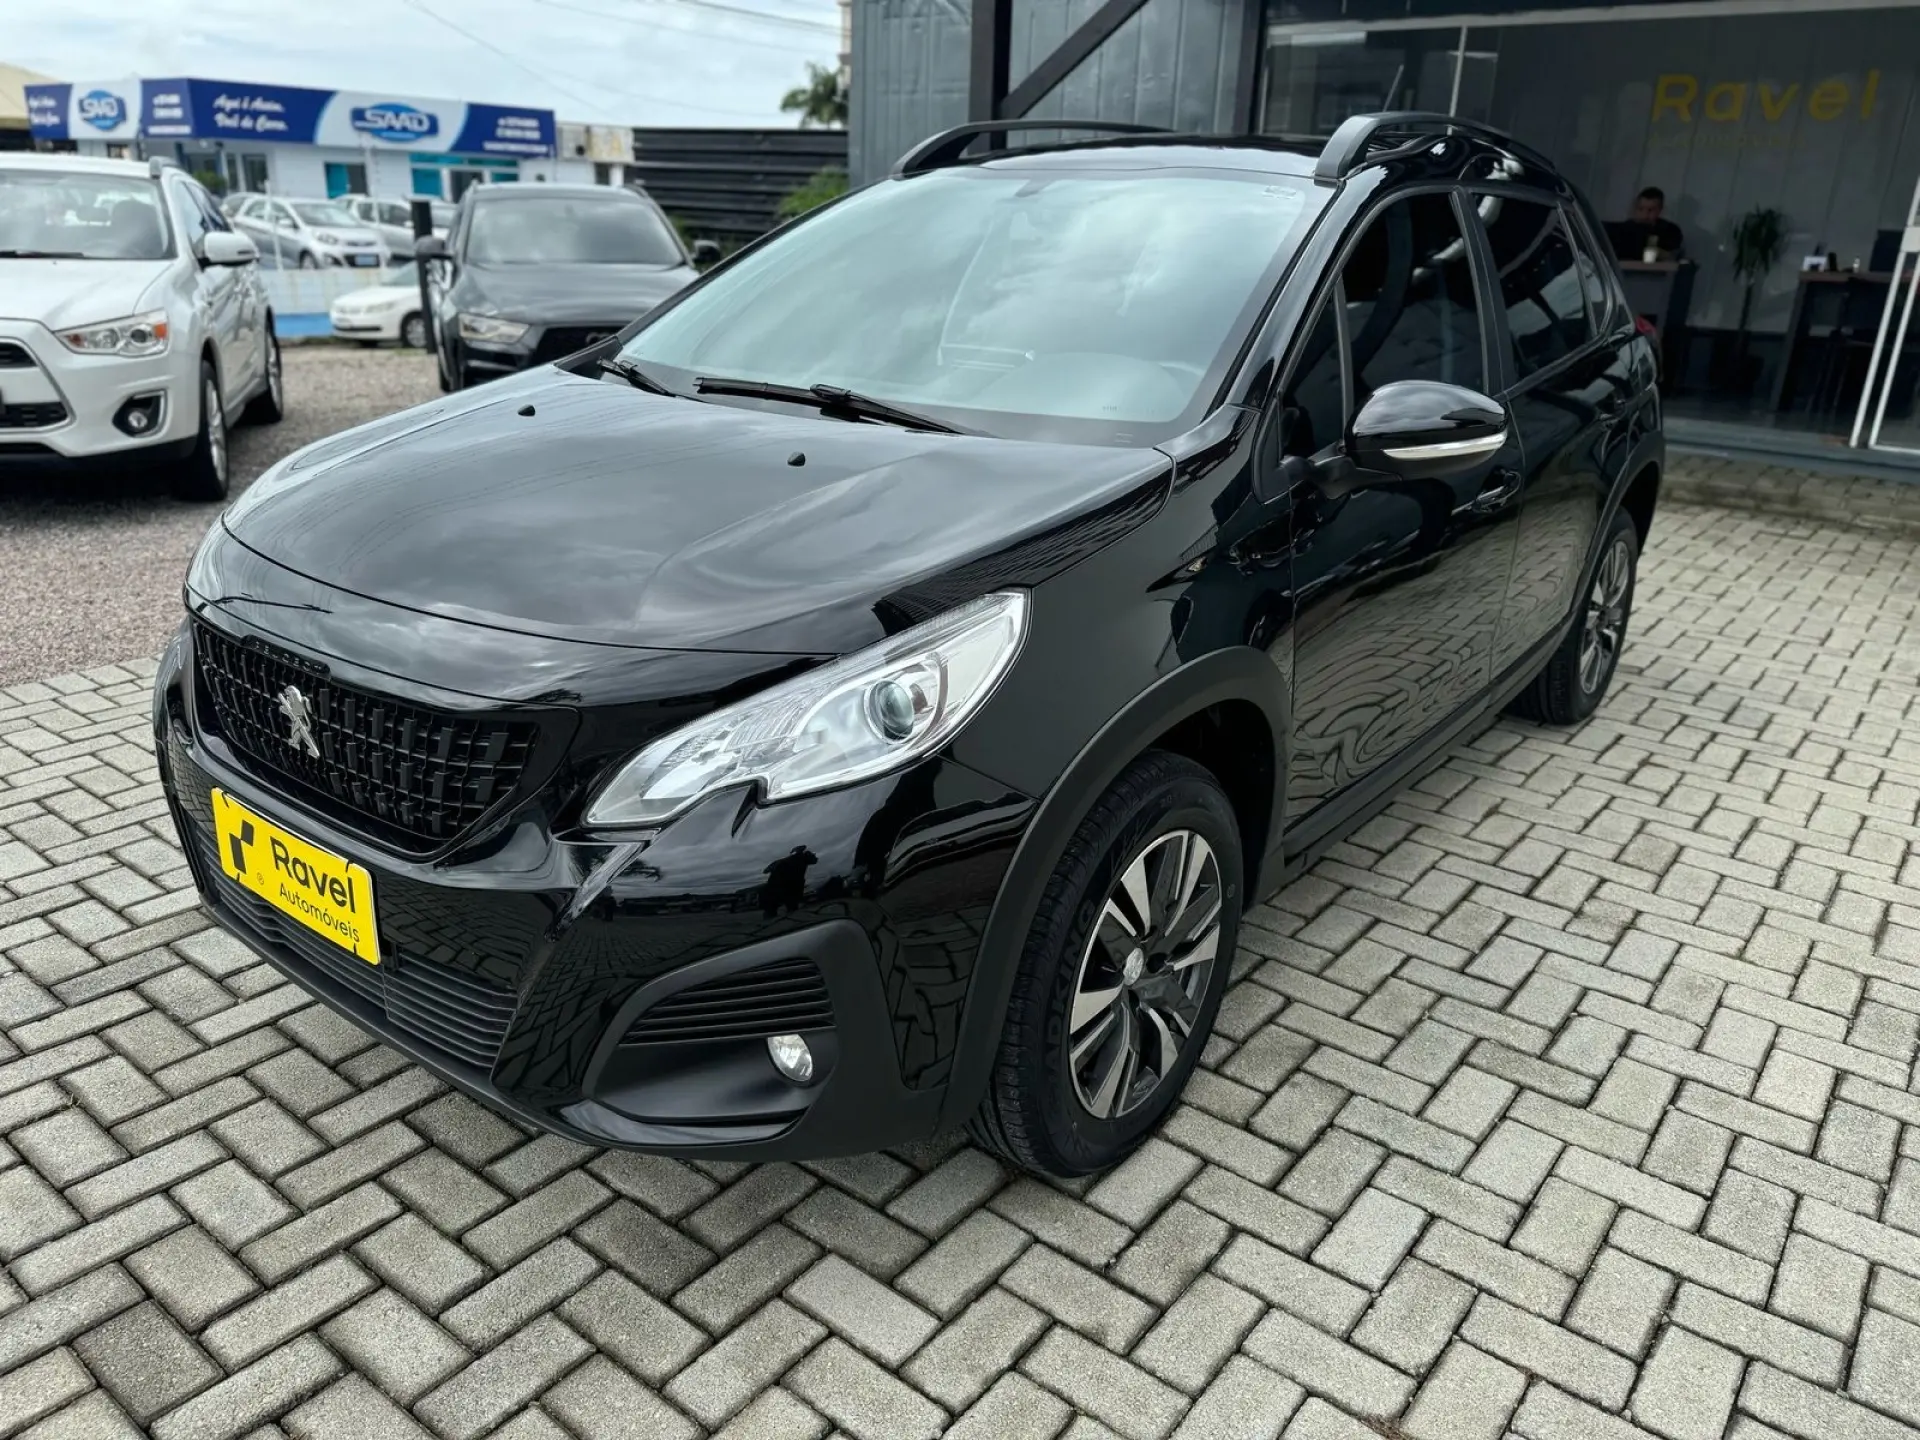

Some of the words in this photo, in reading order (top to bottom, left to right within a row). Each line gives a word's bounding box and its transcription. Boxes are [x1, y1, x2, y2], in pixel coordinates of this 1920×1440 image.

[354, 108, 430, 132] SAAD
[1651, 67, 1881, 122] Ravel
[269, 835, 356, 914] Ravel
[279, 882, 361, 943] Automóveis
